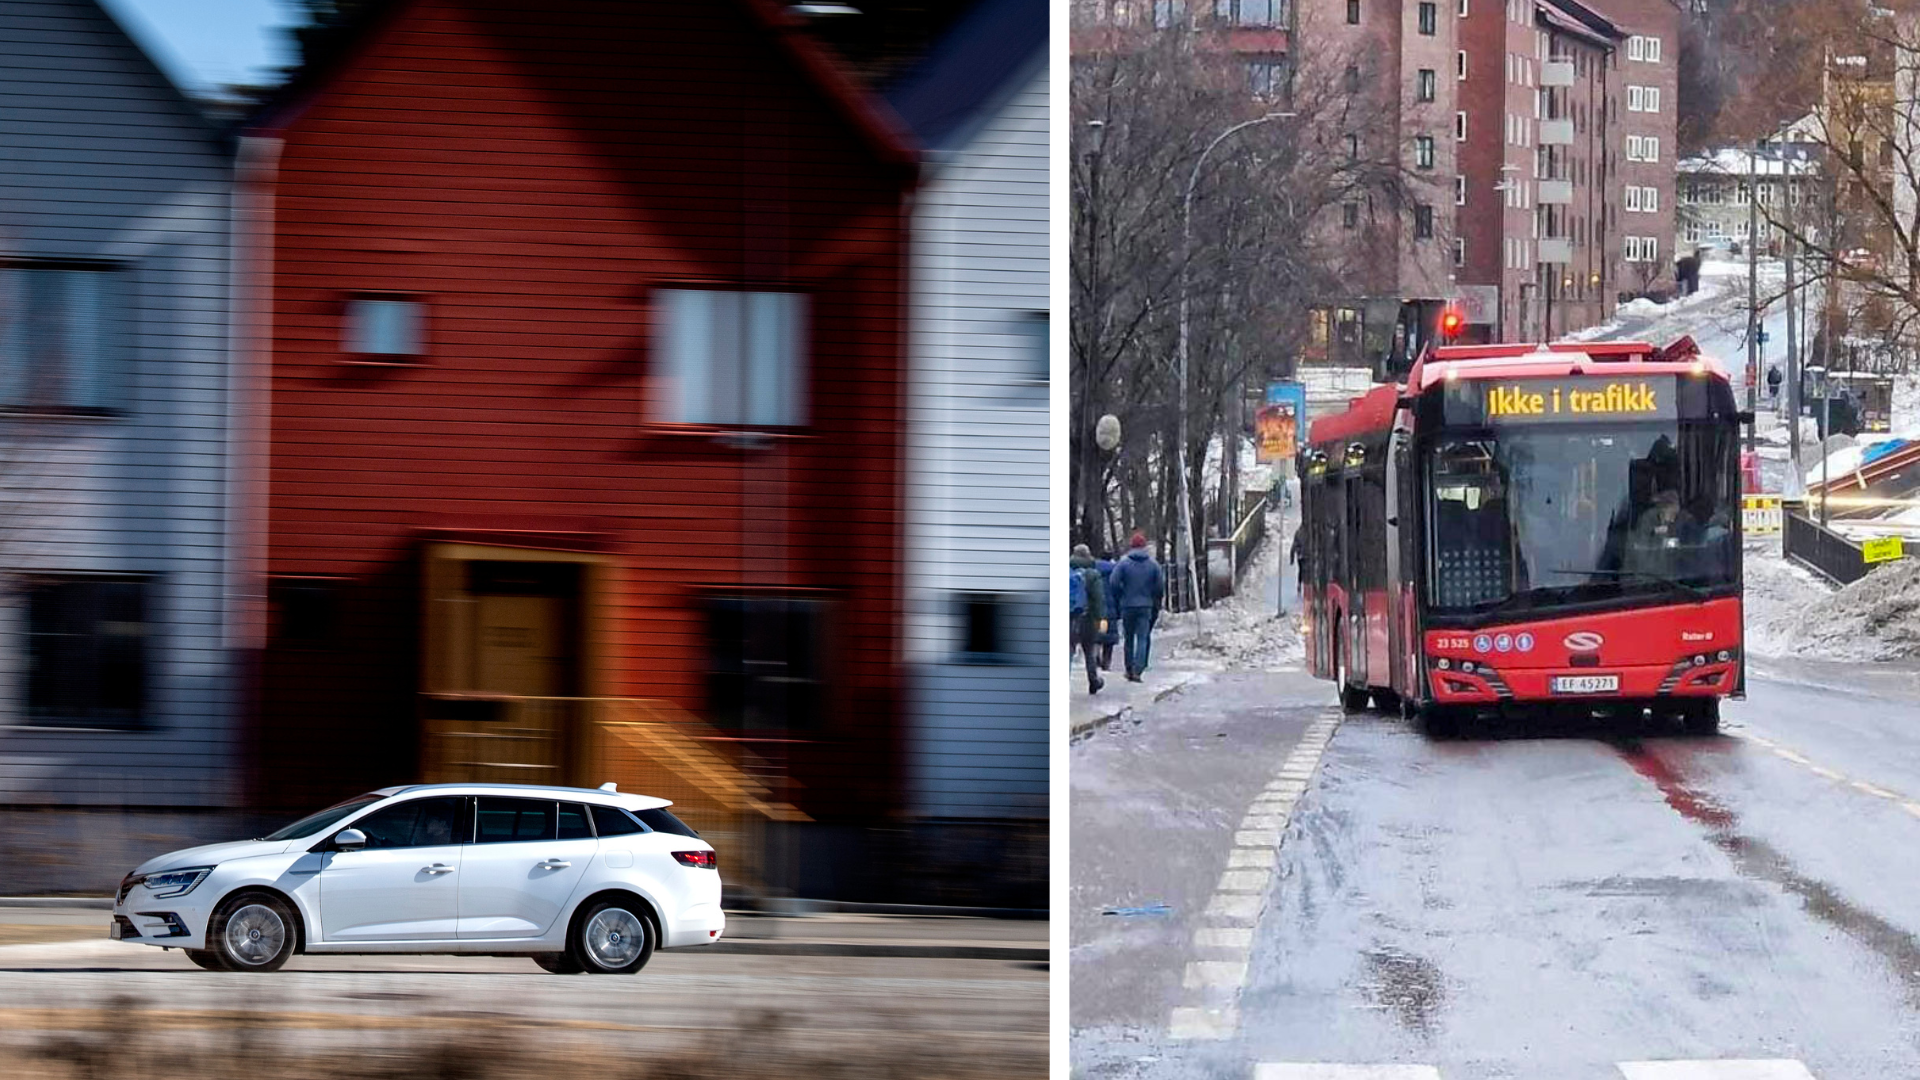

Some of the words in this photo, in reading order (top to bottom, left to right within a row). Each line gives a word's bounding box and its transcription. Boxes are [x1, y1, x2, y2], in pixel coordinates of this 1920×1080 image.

[1490, 386, 1544, 415] Ikke
[1553, 388, 1560, 414] i
[1569, 383, 1657, 413] trafikk
[1579, 678, 1614, 690] 45271
